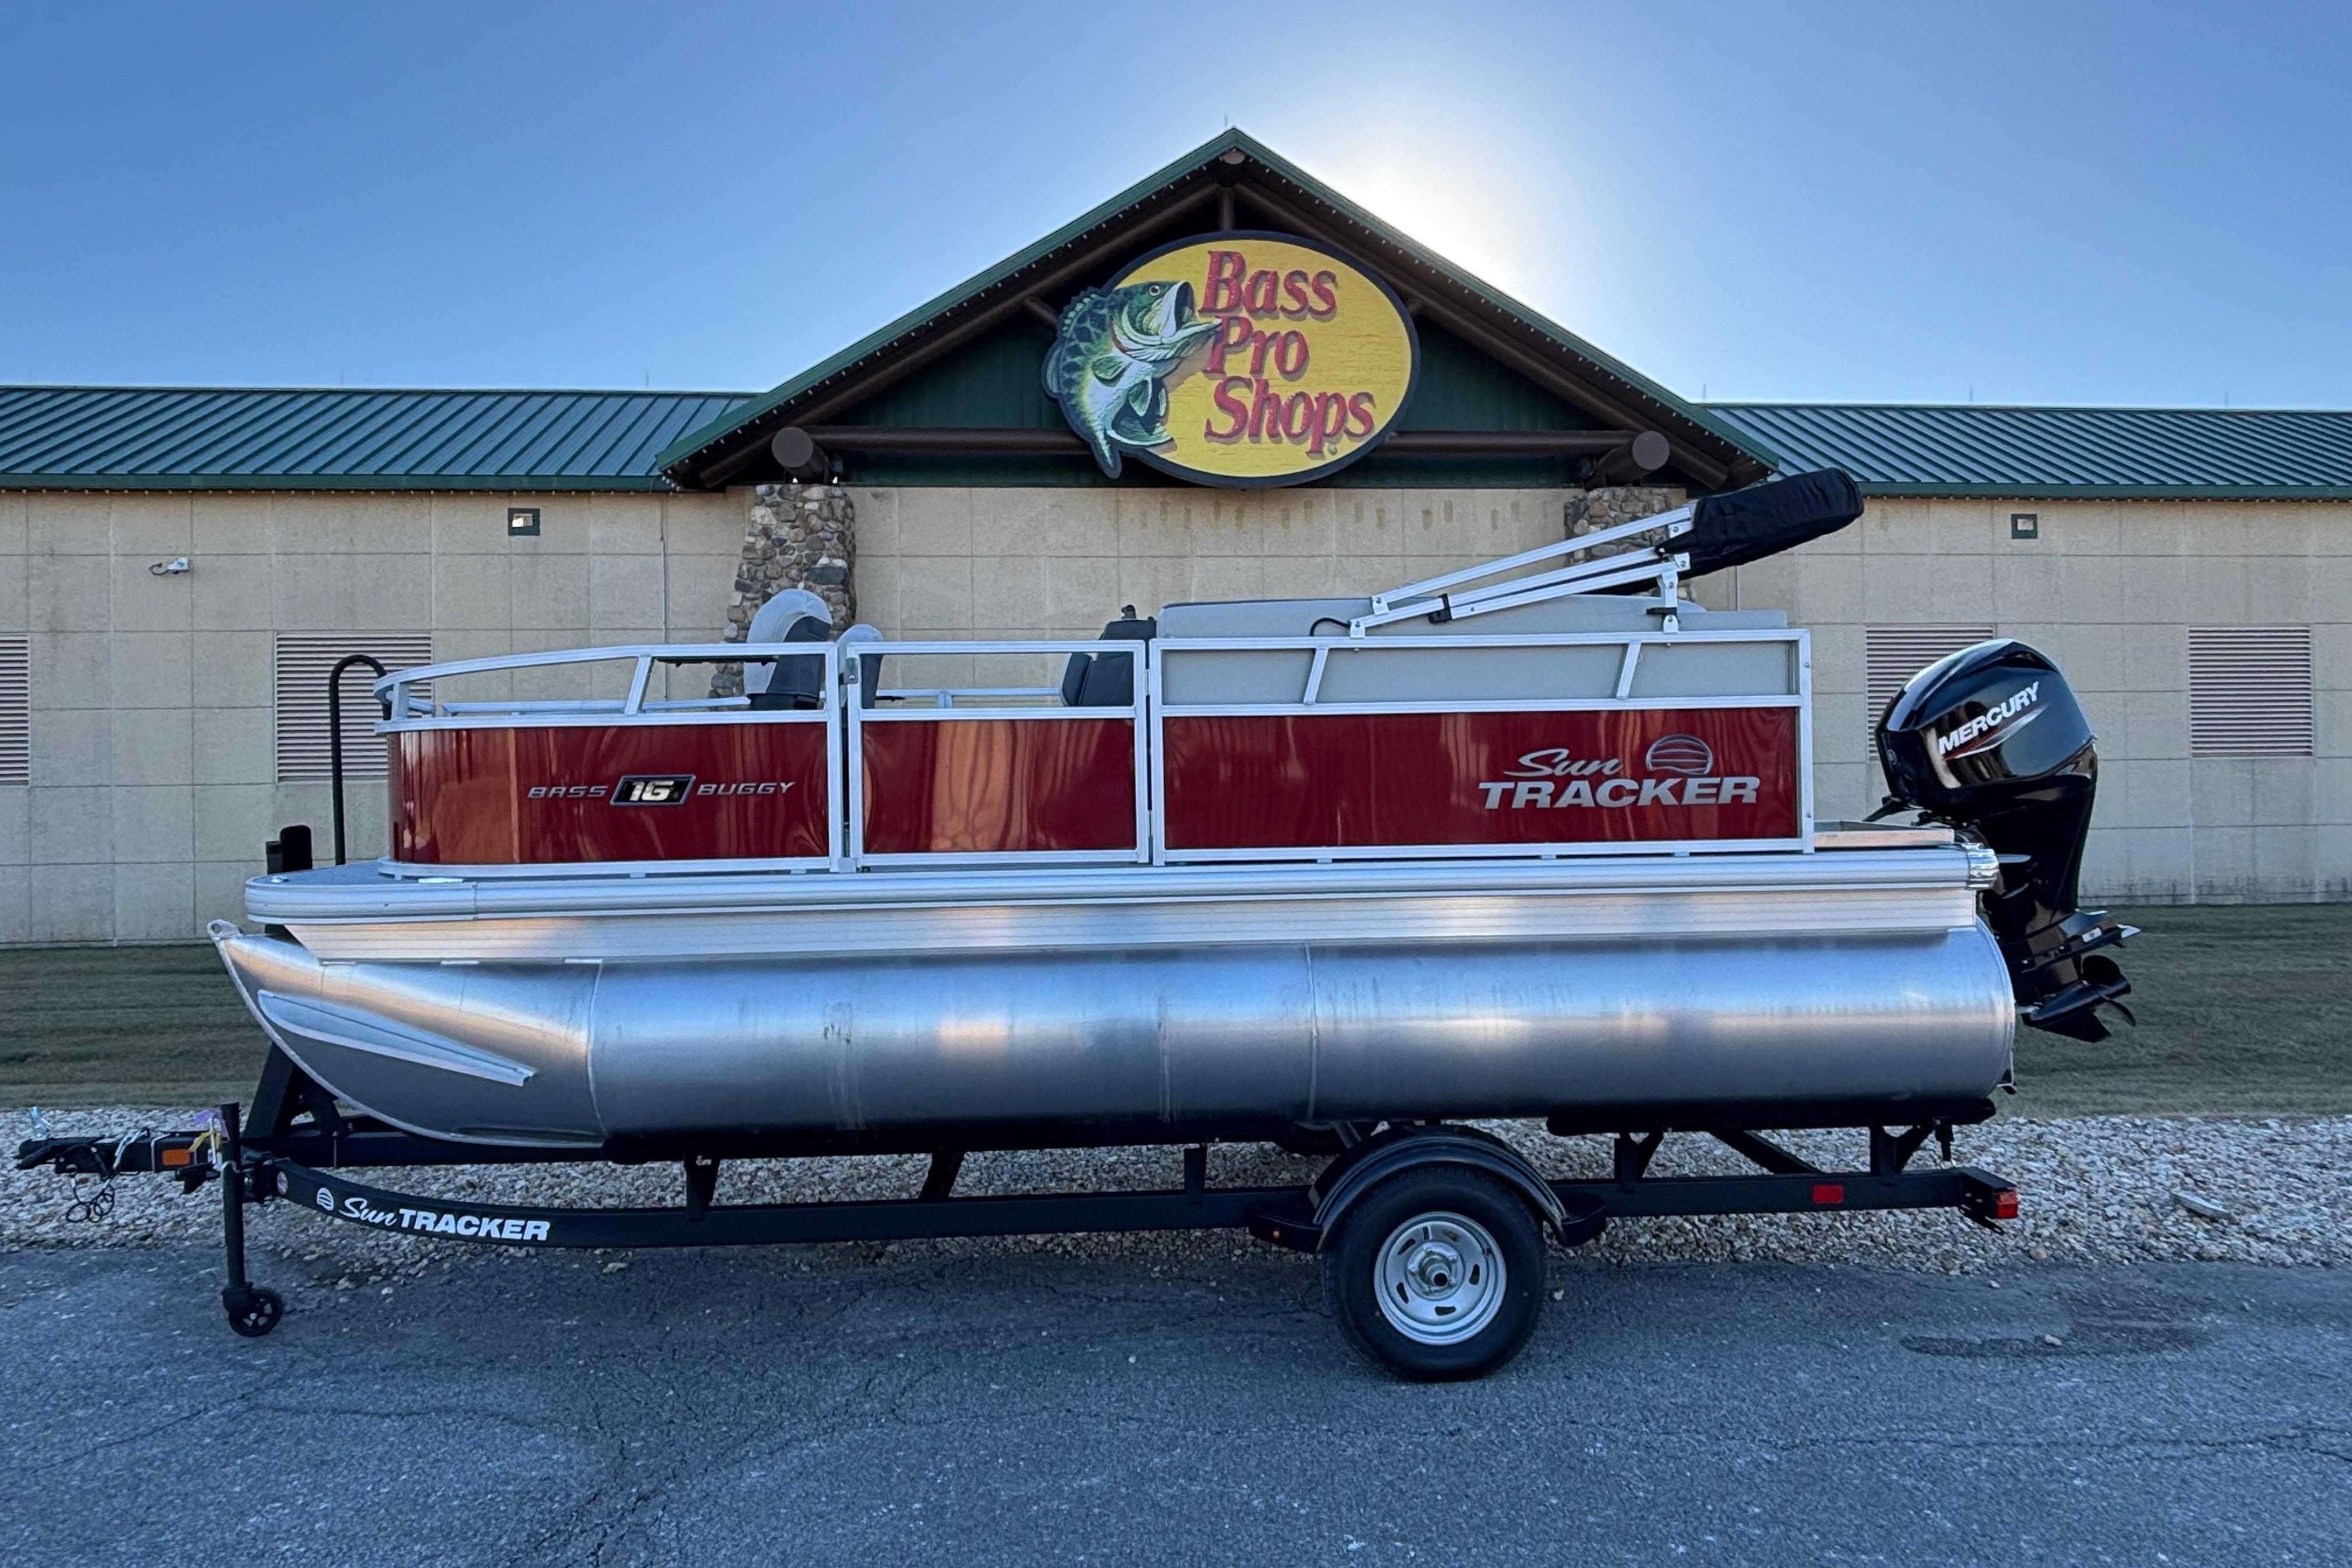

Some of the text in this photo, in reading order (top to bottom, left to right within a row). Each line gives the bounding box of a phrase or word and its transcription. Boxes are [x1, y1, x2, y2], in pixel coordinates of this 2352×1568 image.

[1198, 250, 1338, 316] Bass
[1202, 315, 1309, 376] Pro
[1204, 376, 1376, 456] Shops
[1938, 681, 2039, 755] MERCURY
[1503, 748, 1624, 776] Sun
[527, 780, 796, 802] BASS 16 BUGGY
[1479, 776, 1760, 810] TRACKER
[339, 1197, 551, 1241] Sun TRACKER
